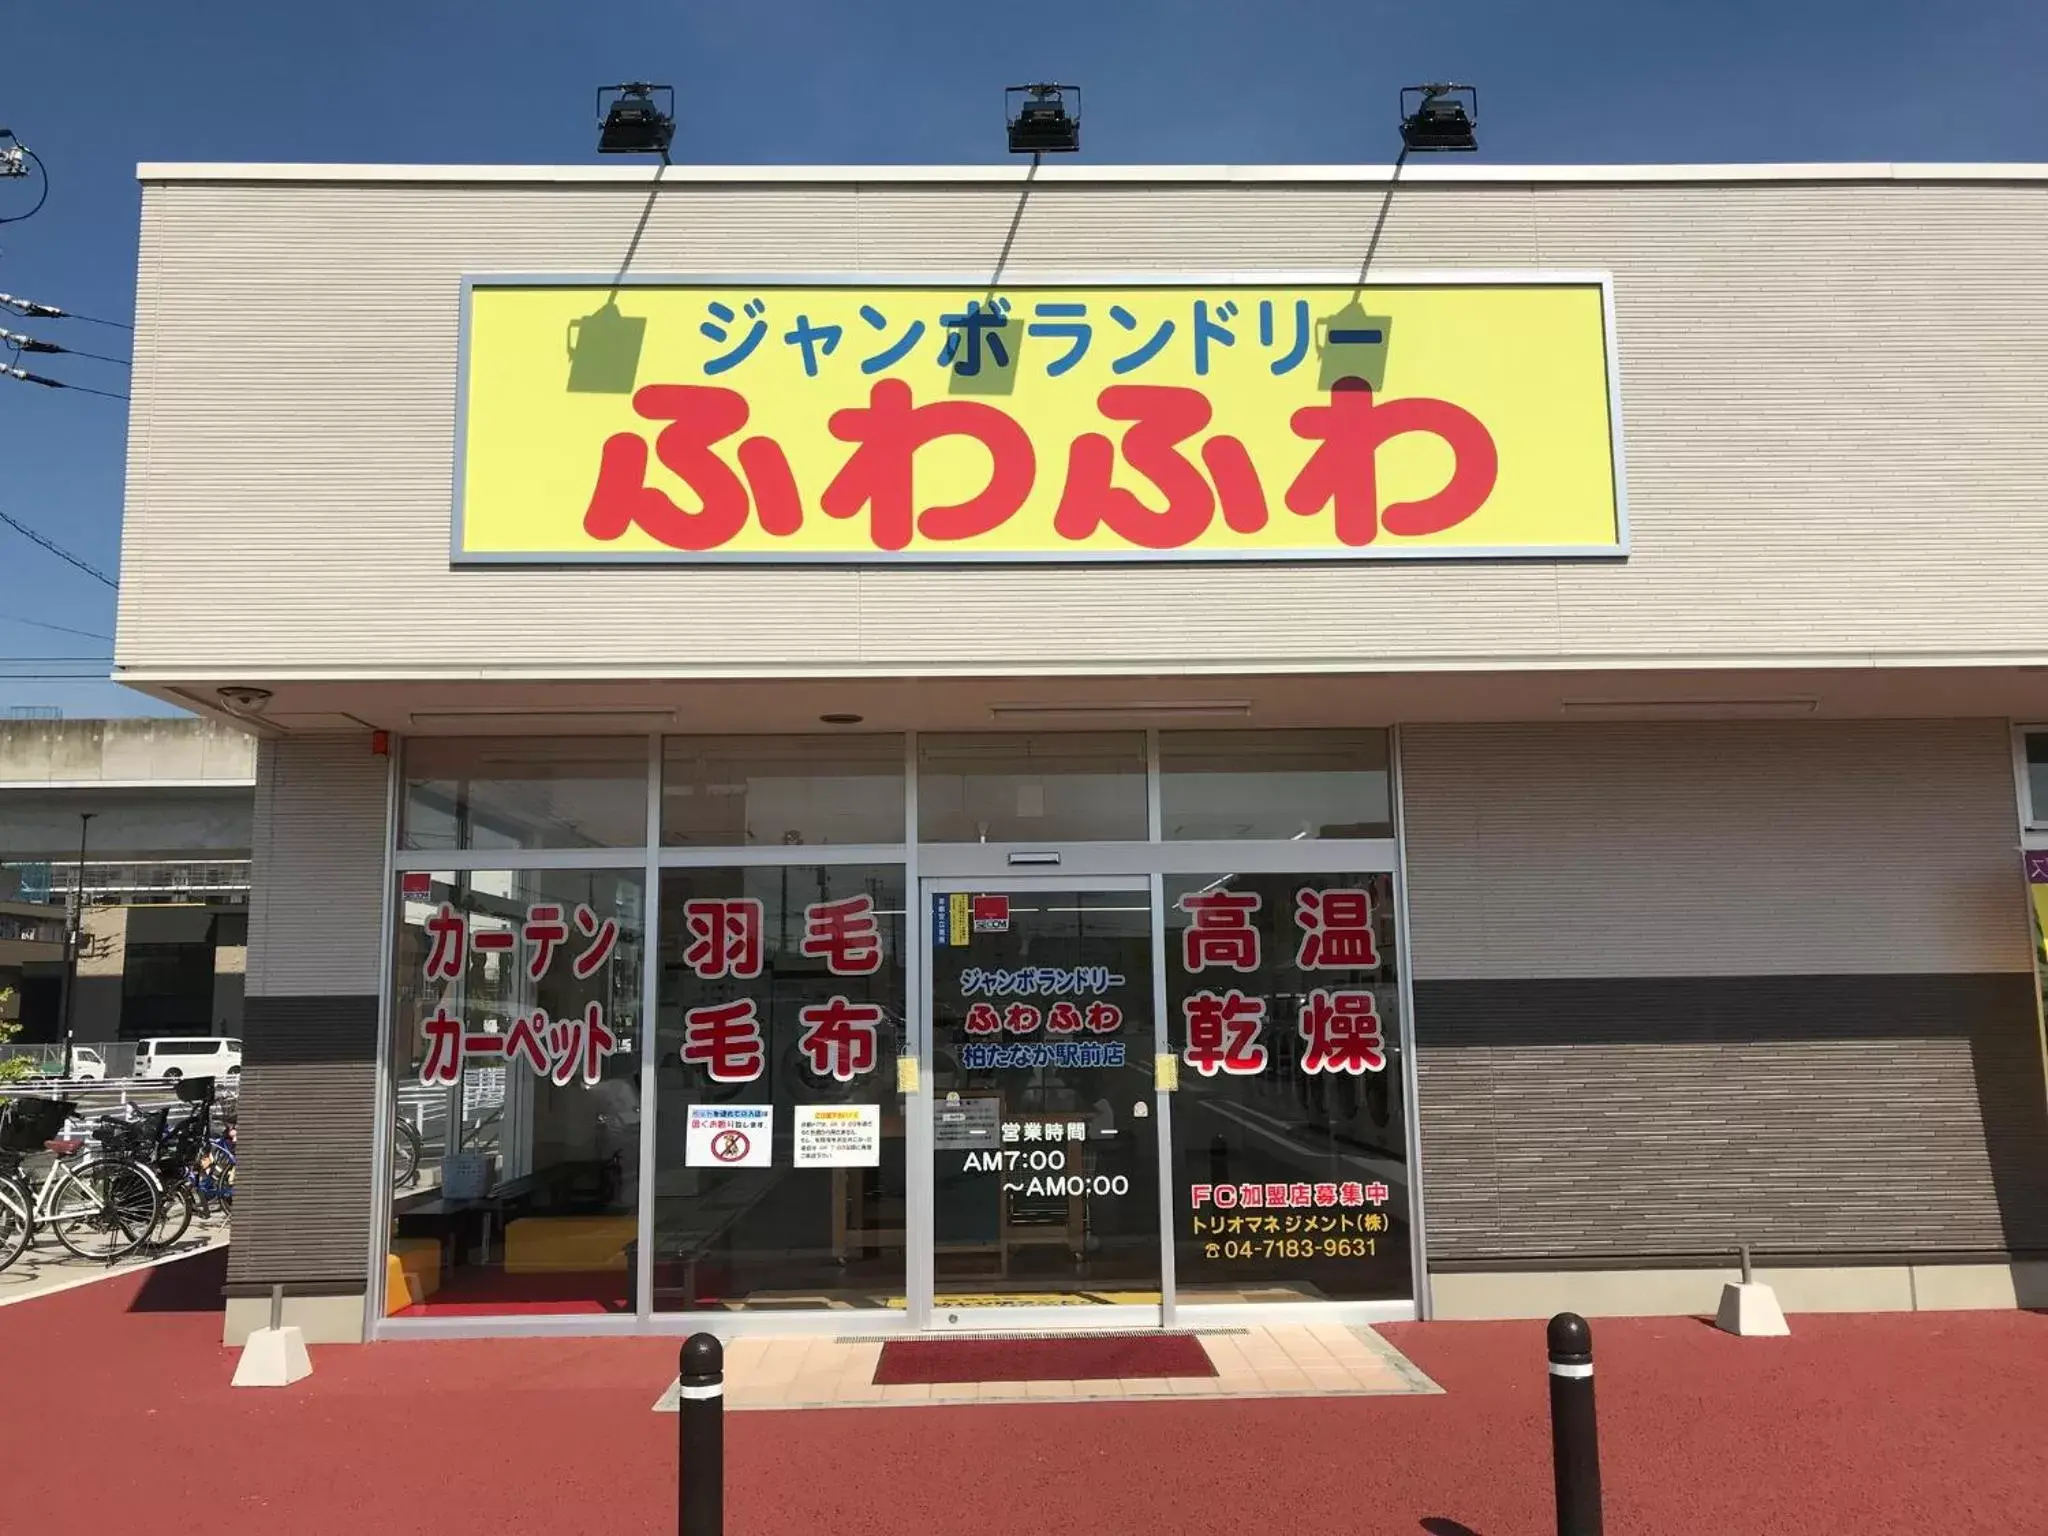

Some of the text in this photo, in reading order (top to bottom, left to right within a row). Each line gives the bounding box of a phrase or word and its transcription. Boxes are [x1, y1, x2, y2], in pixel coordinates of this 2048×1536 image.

[700, 299, 1382, 376] ジャンボランドリー
[584, 377, 1498, 550] ふわふわ
[425, 902, 620, 981] カーテン
[1180, 888, 1380, 972] 高温
[960, 966, 1125, 996] ジャンボランドリー
[965, 1001, 1122, 1034] ふわふわ
[420, 1001, 616, 1086] カーペット
[1183, 990, 1386, 1077] 乾燥
[963, 1042, 1125, 1069] 柏たなか駅前店
[1001, 1122, 1086, 1142] 営業時間
[963, 1150, 1065, 1171] AM7:00
[1191, 1181, 1389, 1209] FC加盟店募集中
[1193, 1213, 1389, 1235] トリオマネジメント(株)
[1224, 1238, 1376, 1258] 04-7183-9631
